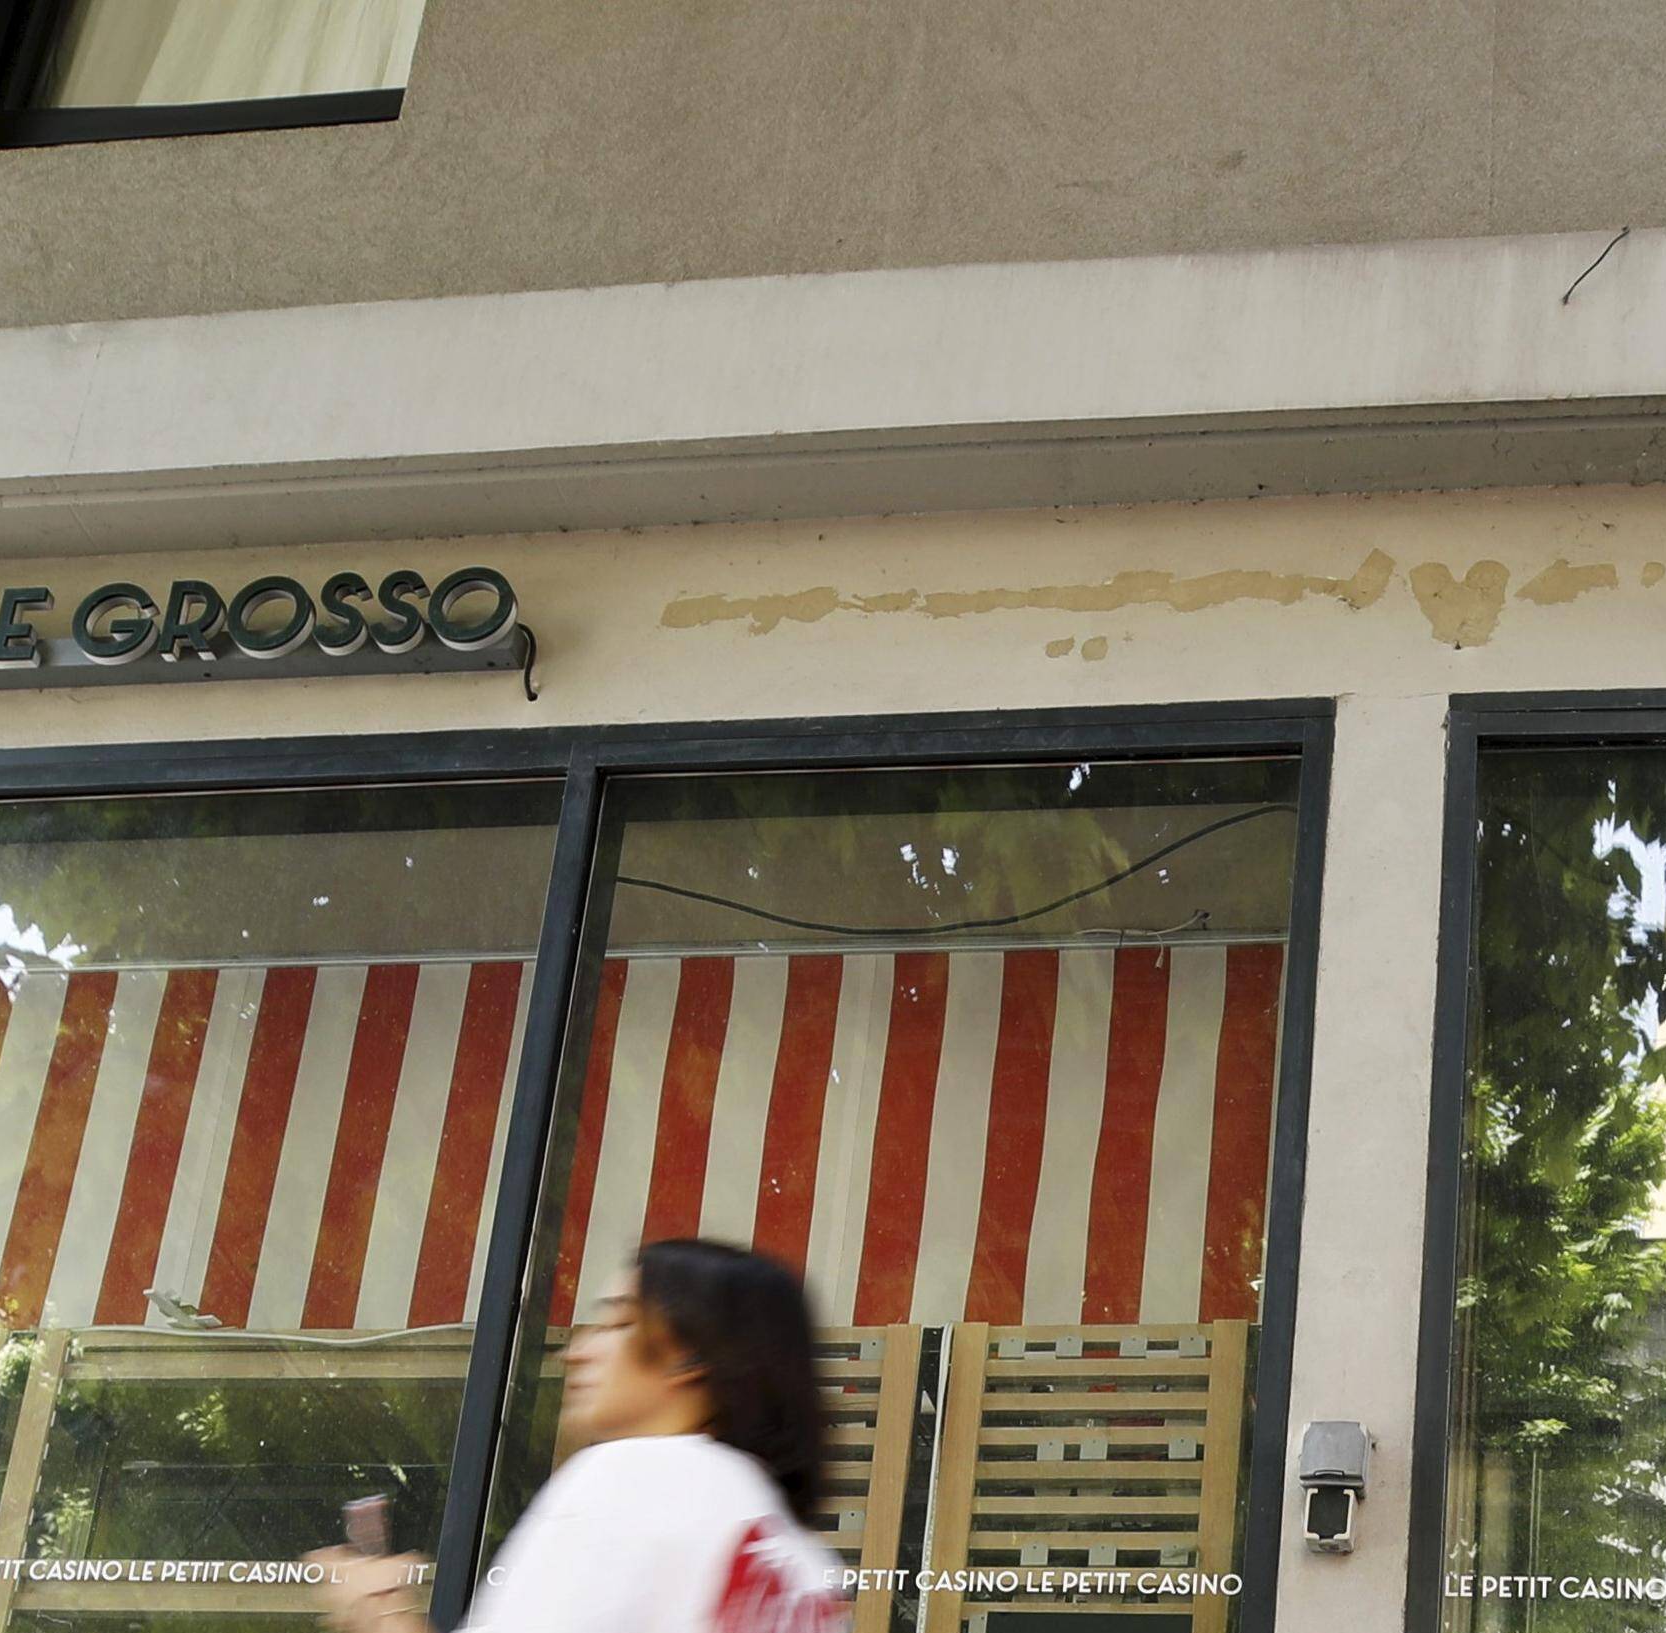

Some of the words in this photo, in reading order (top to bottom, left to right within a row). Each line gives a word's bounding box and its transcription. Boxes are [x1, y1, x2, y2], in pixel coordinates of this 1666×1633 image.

[72, 566, 520, 666] GROSSO
[29, 1559, 123, 1582] CASINO
[128, 1561, 157, 1582] LE
[160, 1562, 225, 1583] PETIT
[228, 1562, 325, 1584] CASINO
[841, 1570, 910, 1591] PETIT
[915, 1570, 1019, 1593] CASINO
[1026, 1572, 1054, 1593] LE
[1062, 1572, 1131, 1595] PETIT
[1137, 1573, 1243, 1596] CASINO
[1445, 1575, 1473, 1597] LE
[1481, 1576, 1554, 1598] PETIT
